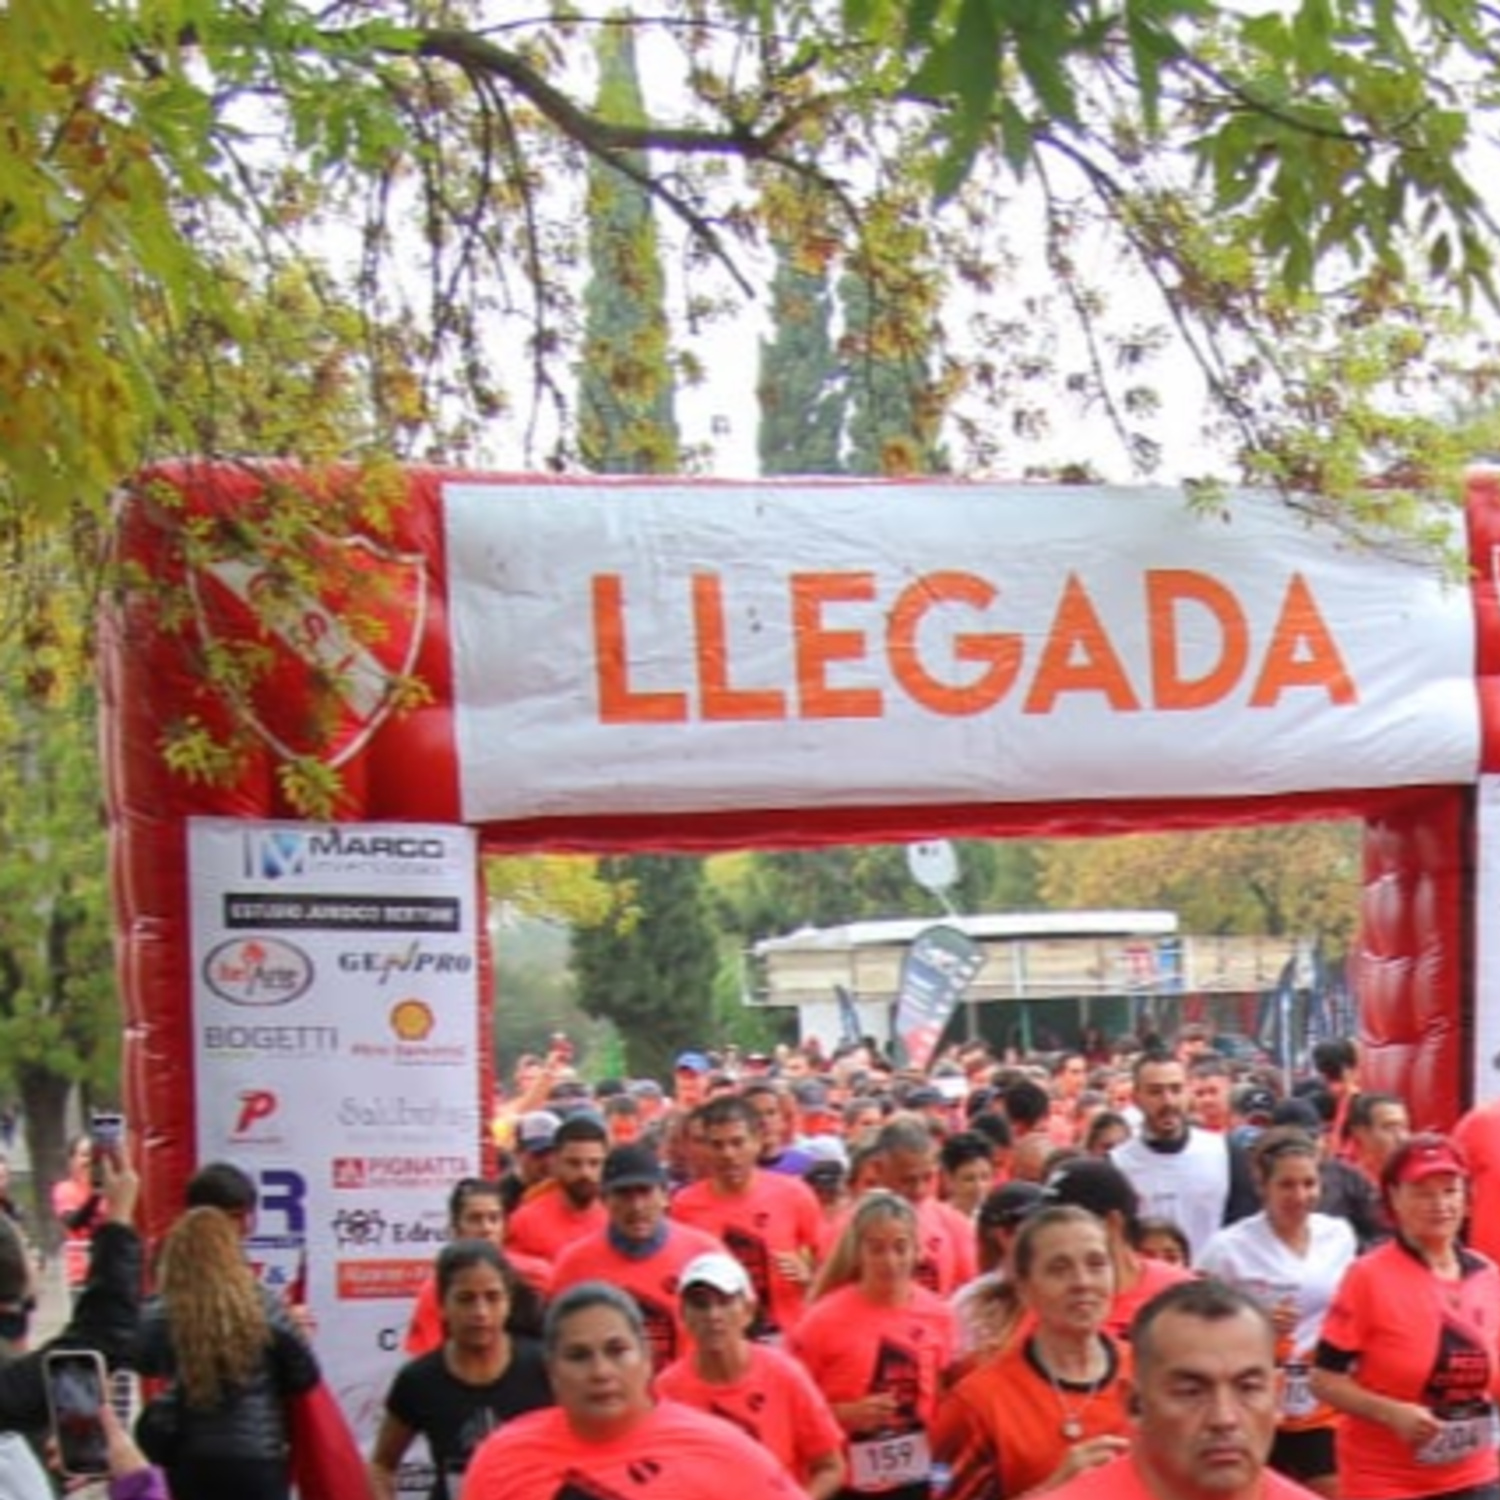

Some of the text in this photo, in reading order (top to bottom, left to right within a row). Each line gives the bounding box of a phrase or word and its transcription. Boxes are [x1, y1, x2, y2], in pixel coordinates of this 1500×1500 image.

[592, 569, 1358, 724] LLEGADA
[204, 1026, 338, 1050] BOGETTI
[866, 1442, 912, 1473] 159
